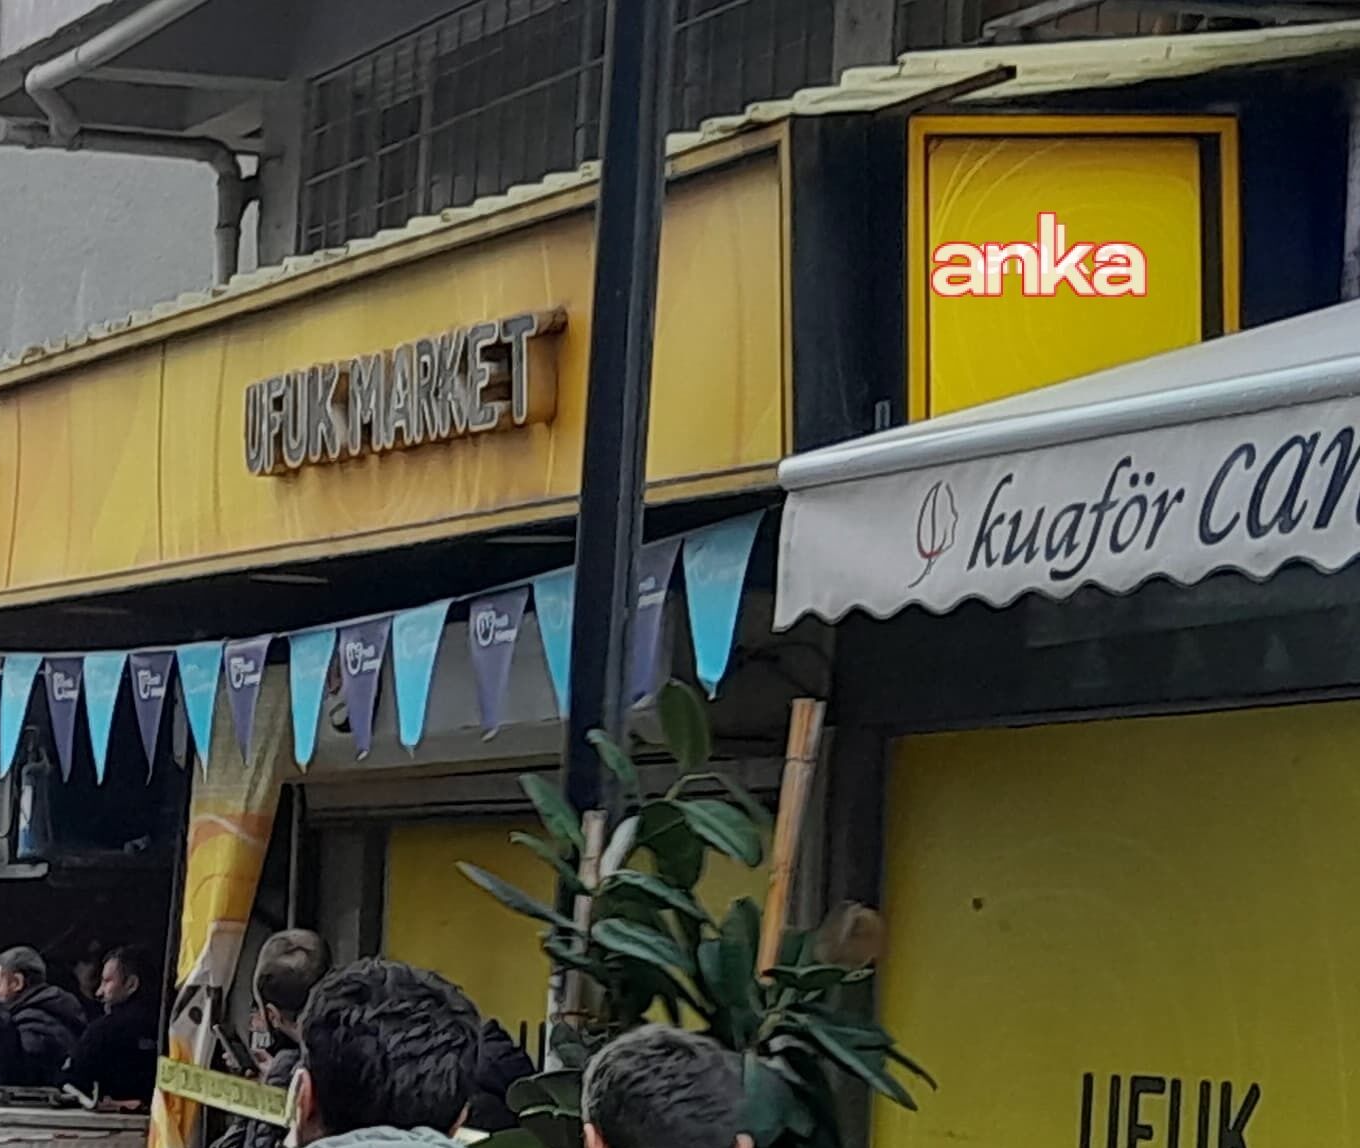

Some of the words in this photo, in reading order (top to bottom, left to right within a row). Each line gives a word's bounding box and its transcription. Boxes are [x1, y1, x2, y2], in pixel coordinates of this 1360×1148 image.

[244, 362, 340, 474] UFUK
[348, 313, 539, 456] MARKET
[967, 456, 1184, 581] kuaför
